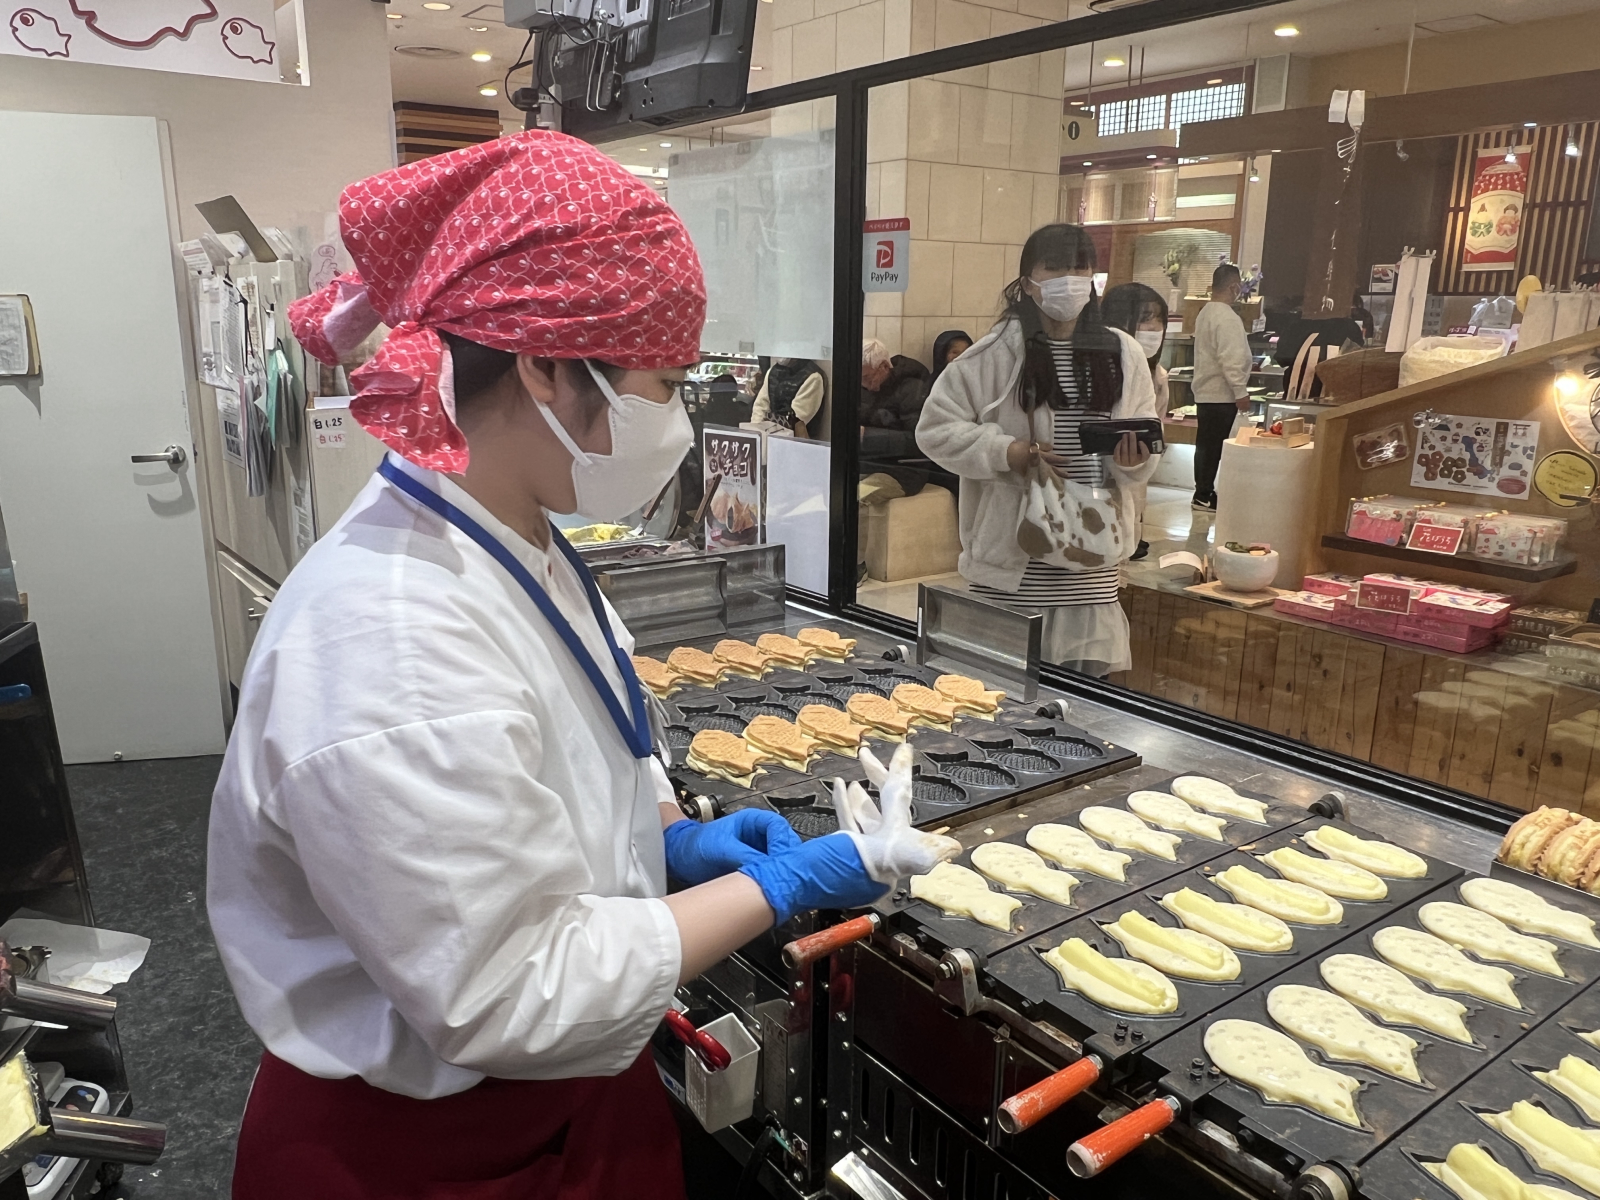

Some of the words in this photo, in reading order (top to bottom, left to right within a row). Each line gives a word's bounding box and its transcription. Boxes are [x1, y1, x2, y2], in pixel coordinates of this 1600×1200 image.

[870, 271, 899, 284] PayPay
[711, 439, 751, 458] サクサク
[723, 458, 748, 475] チョコ
